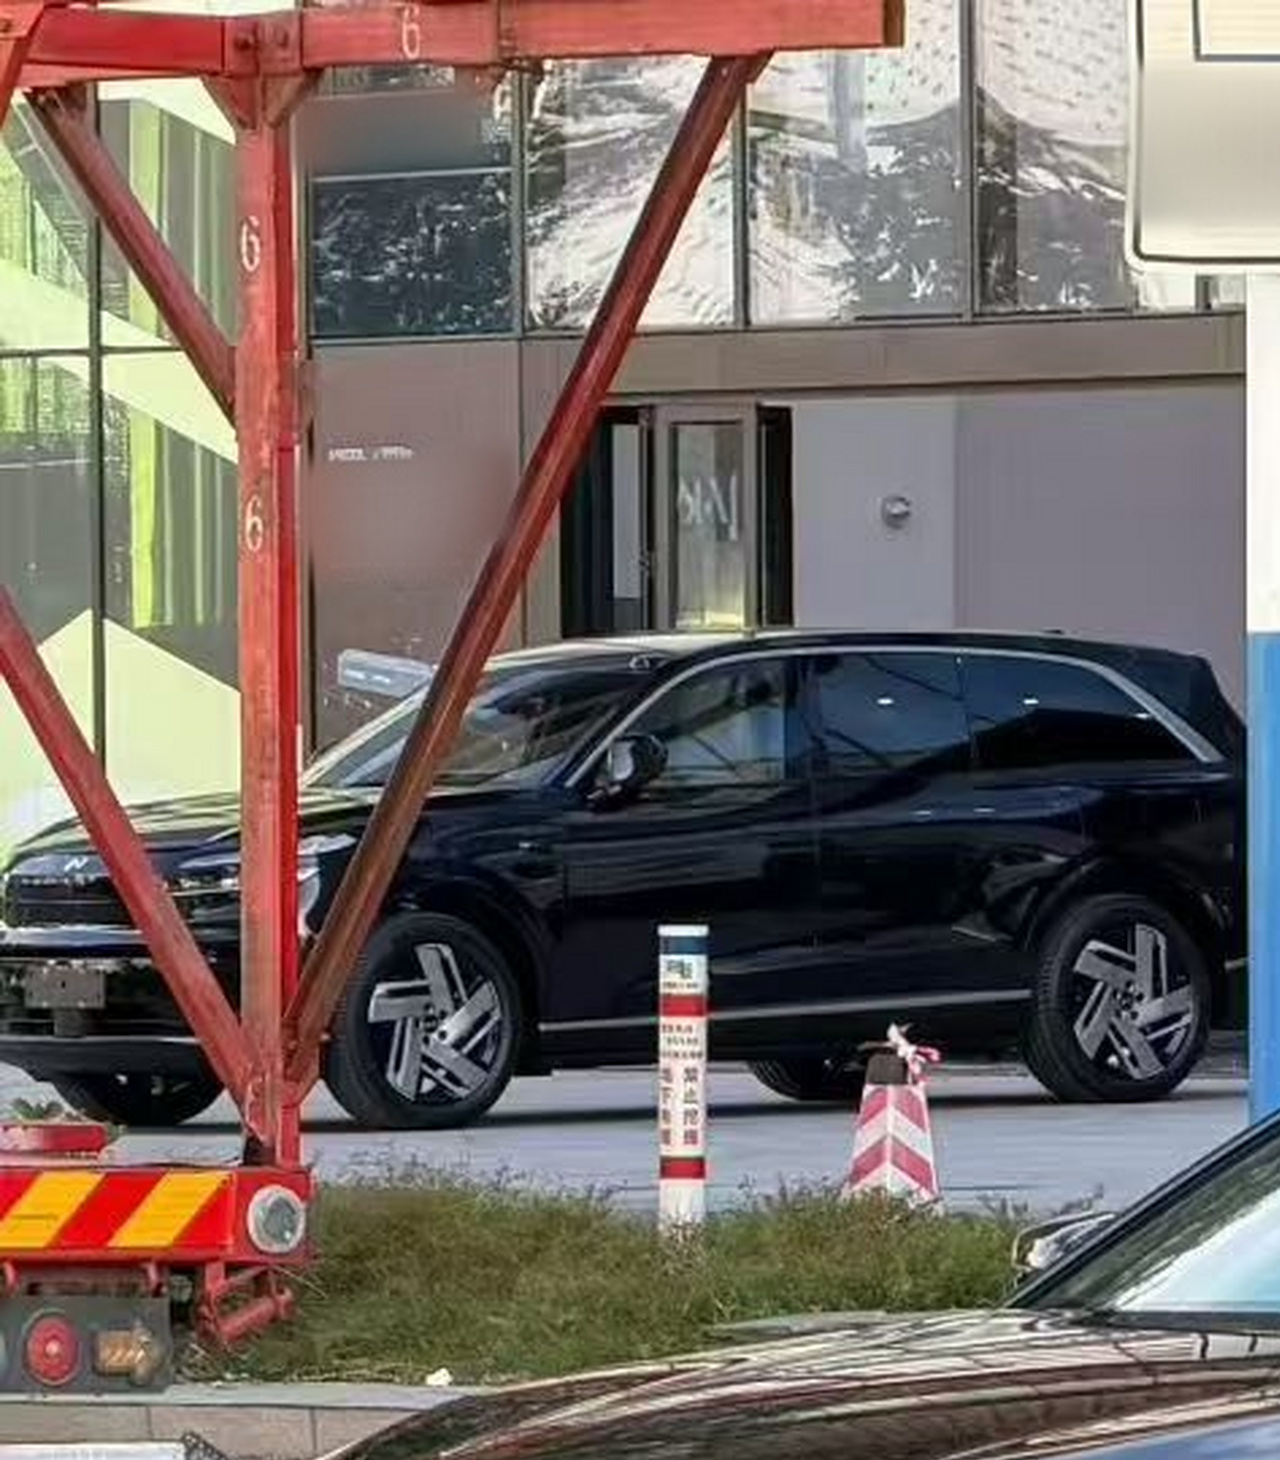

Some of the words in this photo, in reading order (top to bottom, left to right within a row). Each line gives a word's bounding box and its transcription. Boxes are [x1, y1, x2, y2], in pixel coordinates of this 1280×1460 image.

[401, 3, 420, 60] 6
[241, 215, 260, 272] 6
[244, 494, 264, 551] 6
